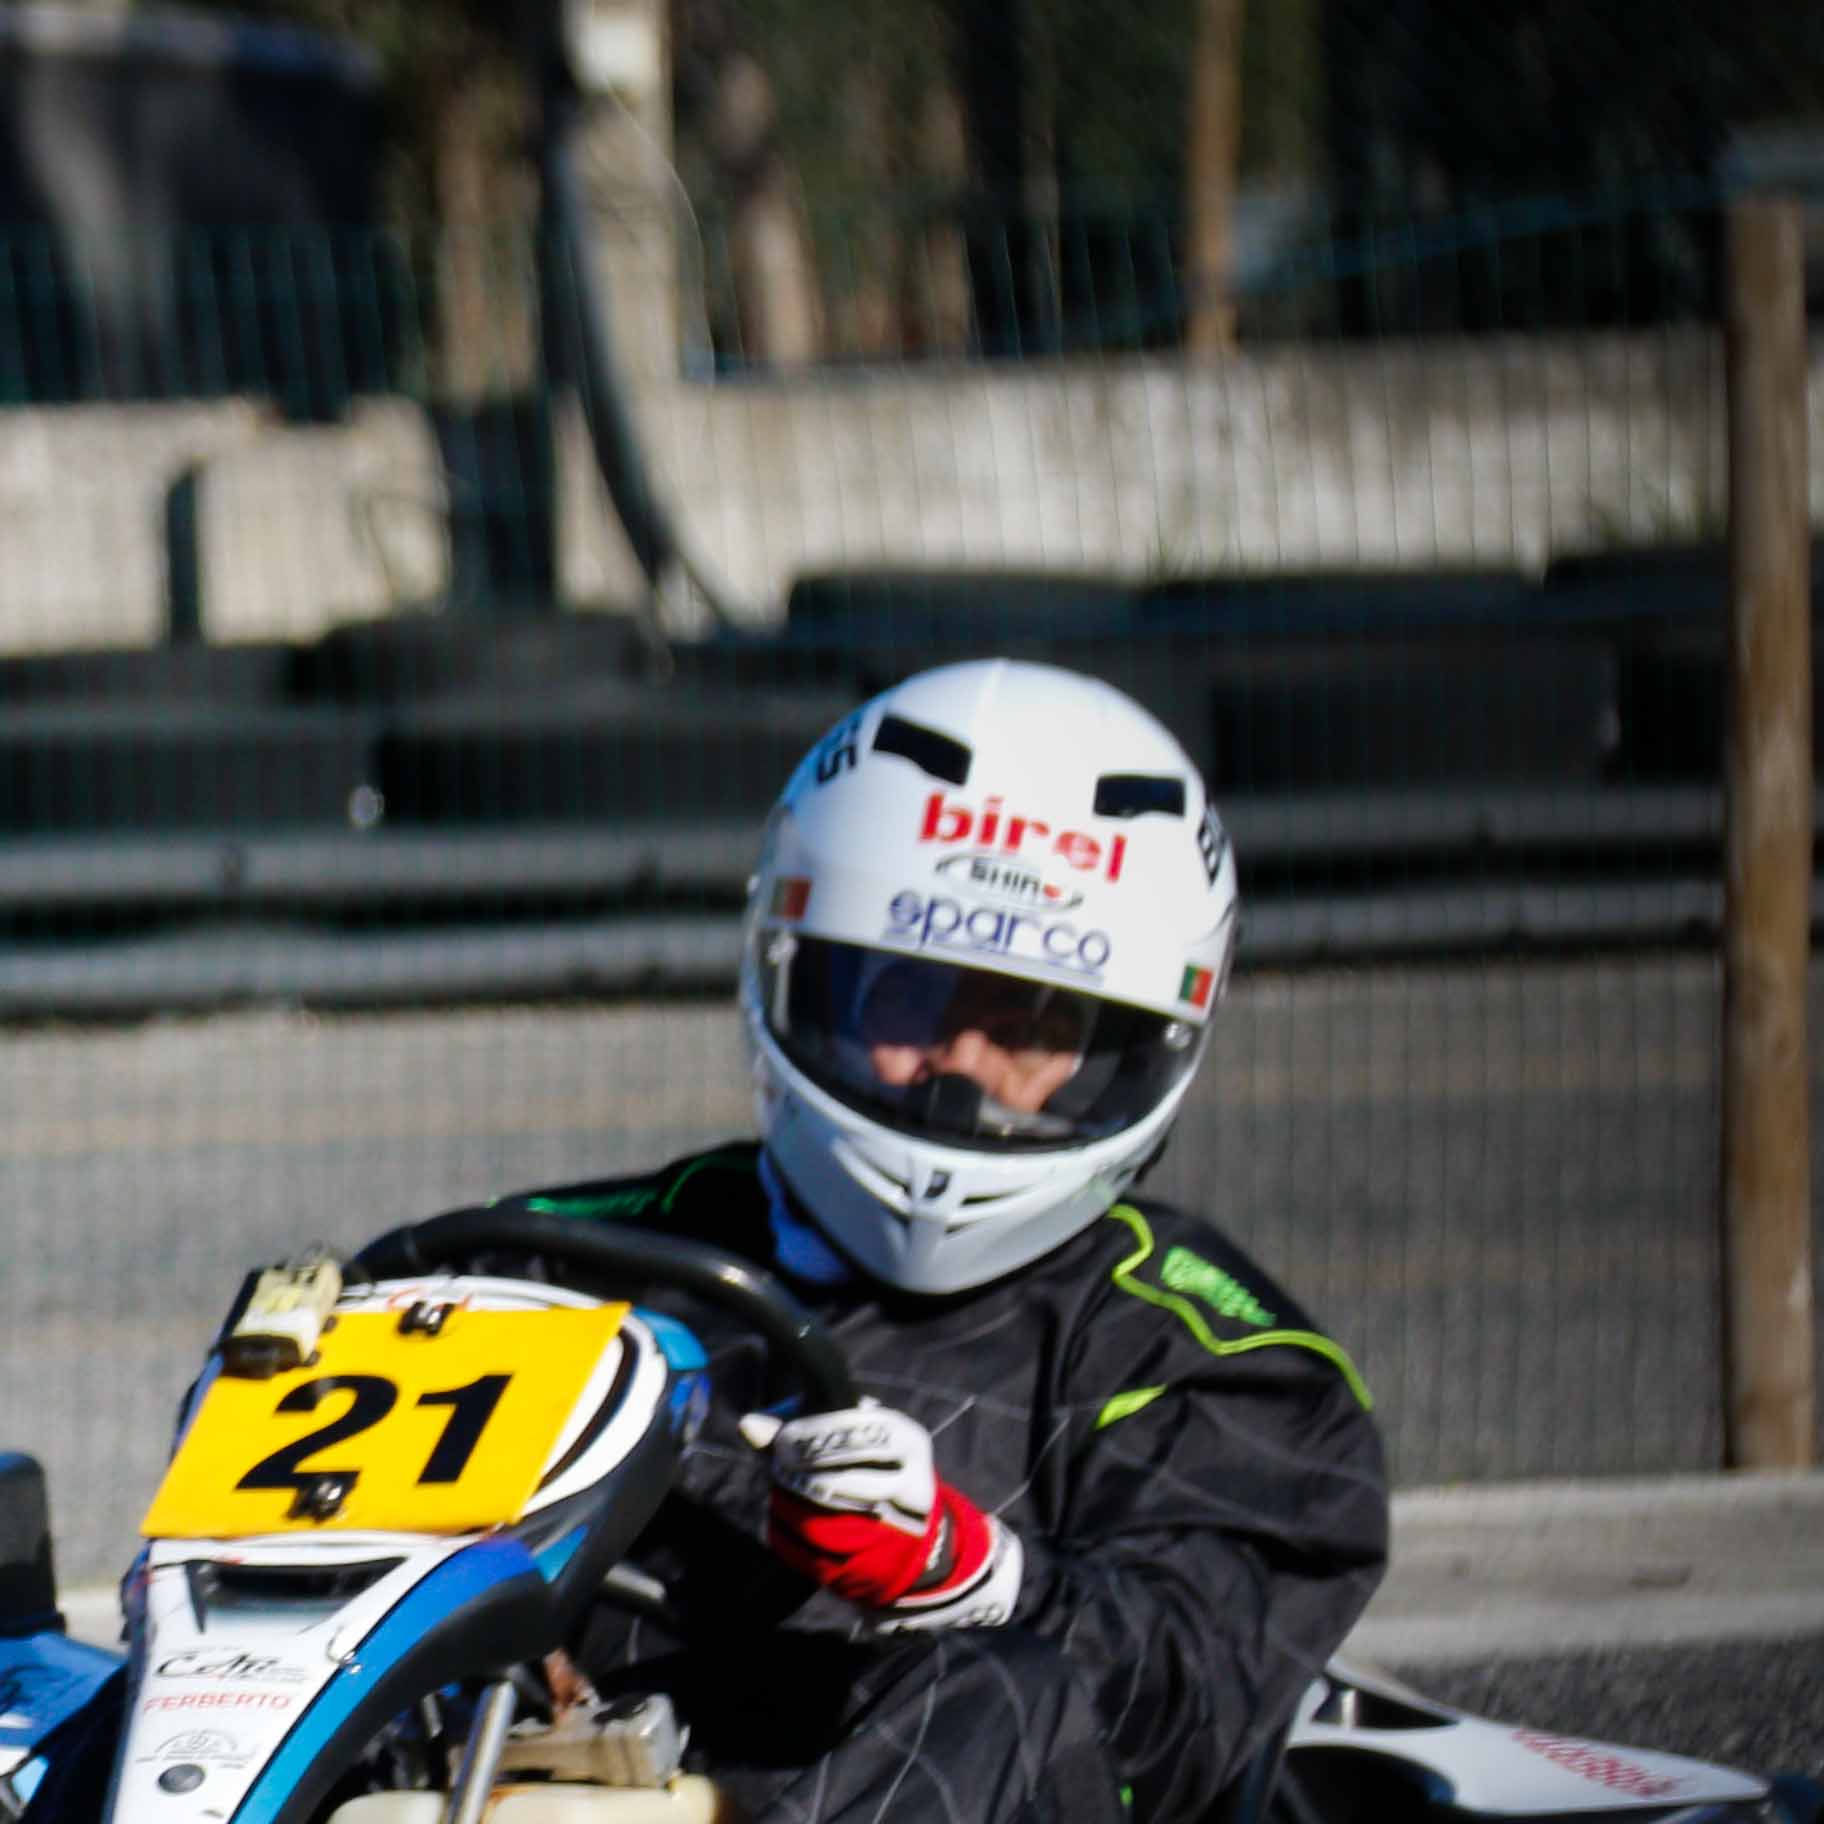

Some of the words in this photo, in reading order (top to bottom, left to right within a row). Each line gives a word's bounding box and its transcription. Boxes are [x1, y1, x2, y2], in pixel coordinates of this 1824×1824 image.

[919, 793, 1126, 883] birel
[888, 890, 1111, 973] sparco
[234, 1372, 518, 1491] 21
